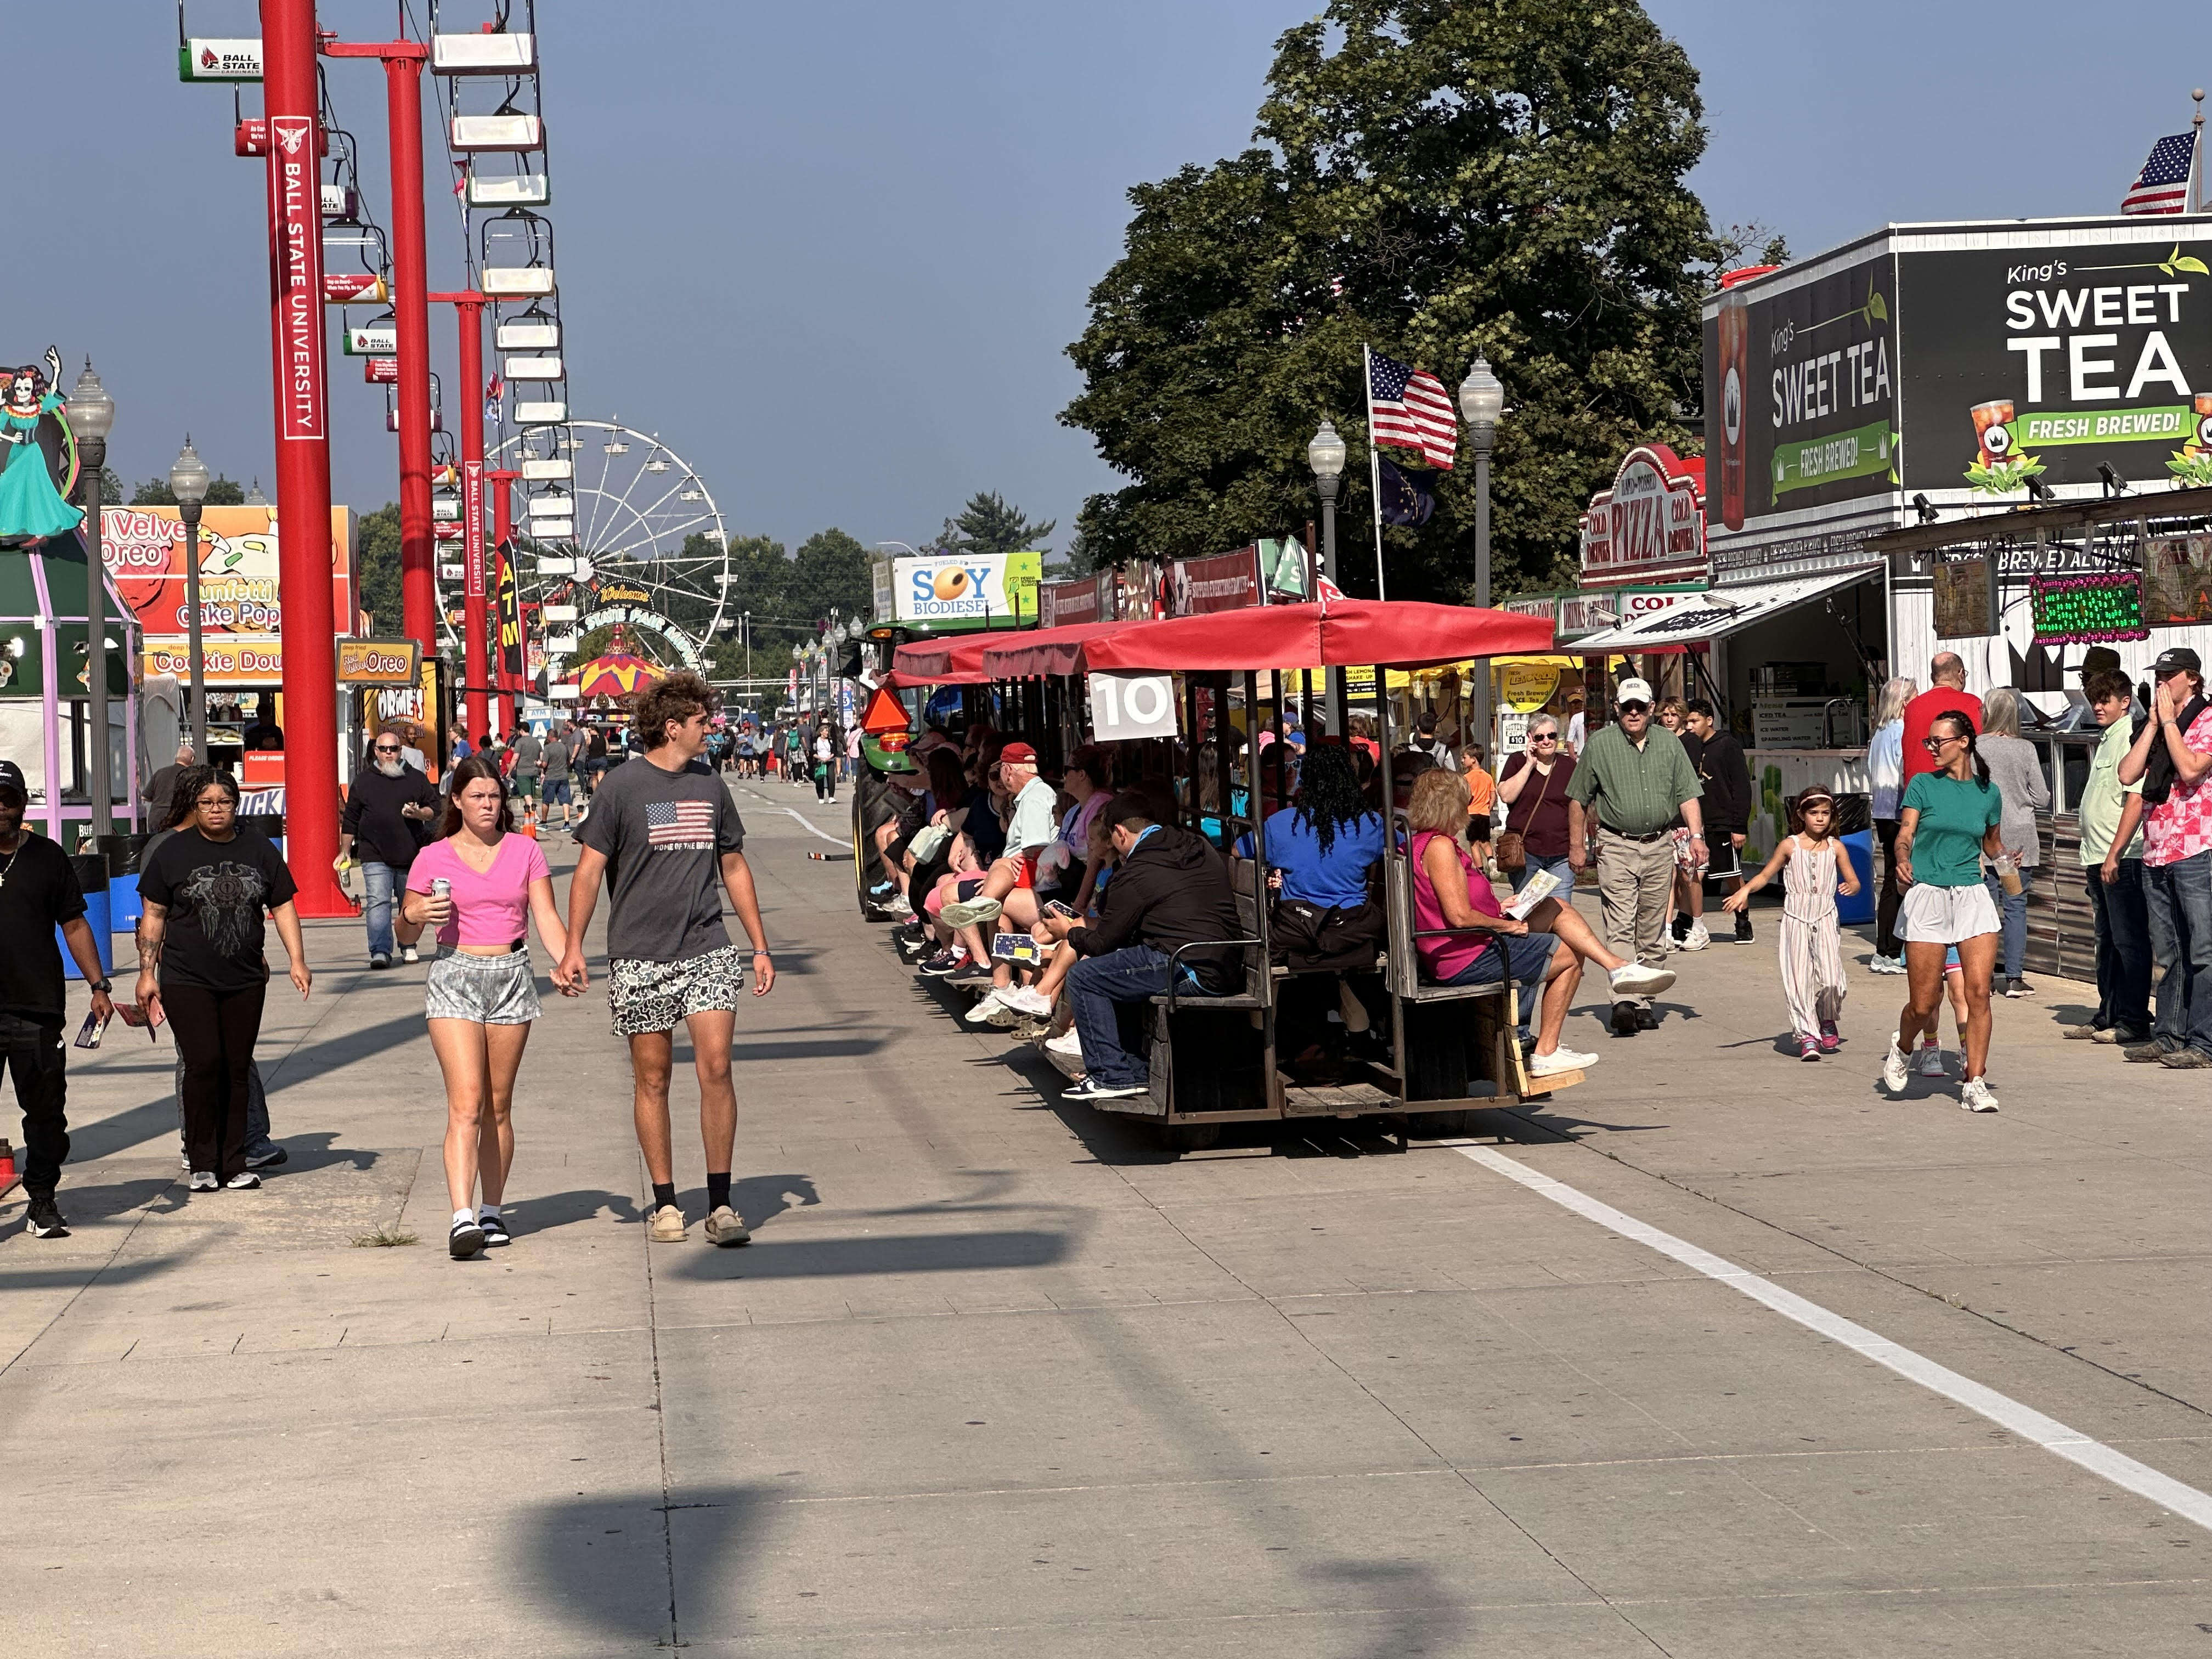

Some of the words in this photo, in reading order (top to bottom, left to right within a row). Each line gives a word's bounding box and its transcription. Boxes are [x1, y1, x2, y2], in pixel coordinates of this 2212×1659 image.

[397, 59, 407, 70] 11
[285, 163, 302, 217] BALL
[287, 223, 305, 287] STATE
[2007, 259, 2067, 284] King's
[2005, 283, 2189, 330] SWEET
[1771, 318, 1794, 358] King's
[291, 295, 313, 428] UNIVERSITY
[2006, 330, 2192, 403] TEA
[1772, 350, 1841, 428] SWEET
[1847, 336, 1891, 408] TEA
[2028, 417, 2090, 439] FRESH
[2096, 412, 2181, 436] BREWED!
[1801, 443, 1824, 478] FRESH
[1825, 436, 1859, 473] BREWED!
[470, 480, 478, 504] BALL
[471, 505, 479, 533] STATE
[1672, 496, 1691, 523] COLD
[113, 512, 188, 539] Velve
[1590, 512, 1608, 535] COLD
[1611, 495, 1667, 563] PIZZA
[1586, 539, 1611, 563] DRINKS
[1668, 526, 1695, 553] DRINKS
[472, 534, 482, 591] UNIVERSITY
[199, 579, 273, 602] unfetti
[600, 584, 650, 603] Welcome
[500, 562, 519, 647] ATM
[913, 599, 993, 615] BIODIESEL
[1564, 601, 1585, 629] DRINKS
[584, 607, 627, 631] STATE
[629, 608, 666, 631] FAIR
[240, 651, 283, 671] Dou
[342, 653, 359, 665] Red
[366, 651, 407, 673] Oreo
[345, 662, 368, 674] Velvet
[1094, 676, 1169, 726] 10
[654, 843, 674, 851] HOME
[674, 842, 682, 850] OF
[683, 842, 696, 850] THE
